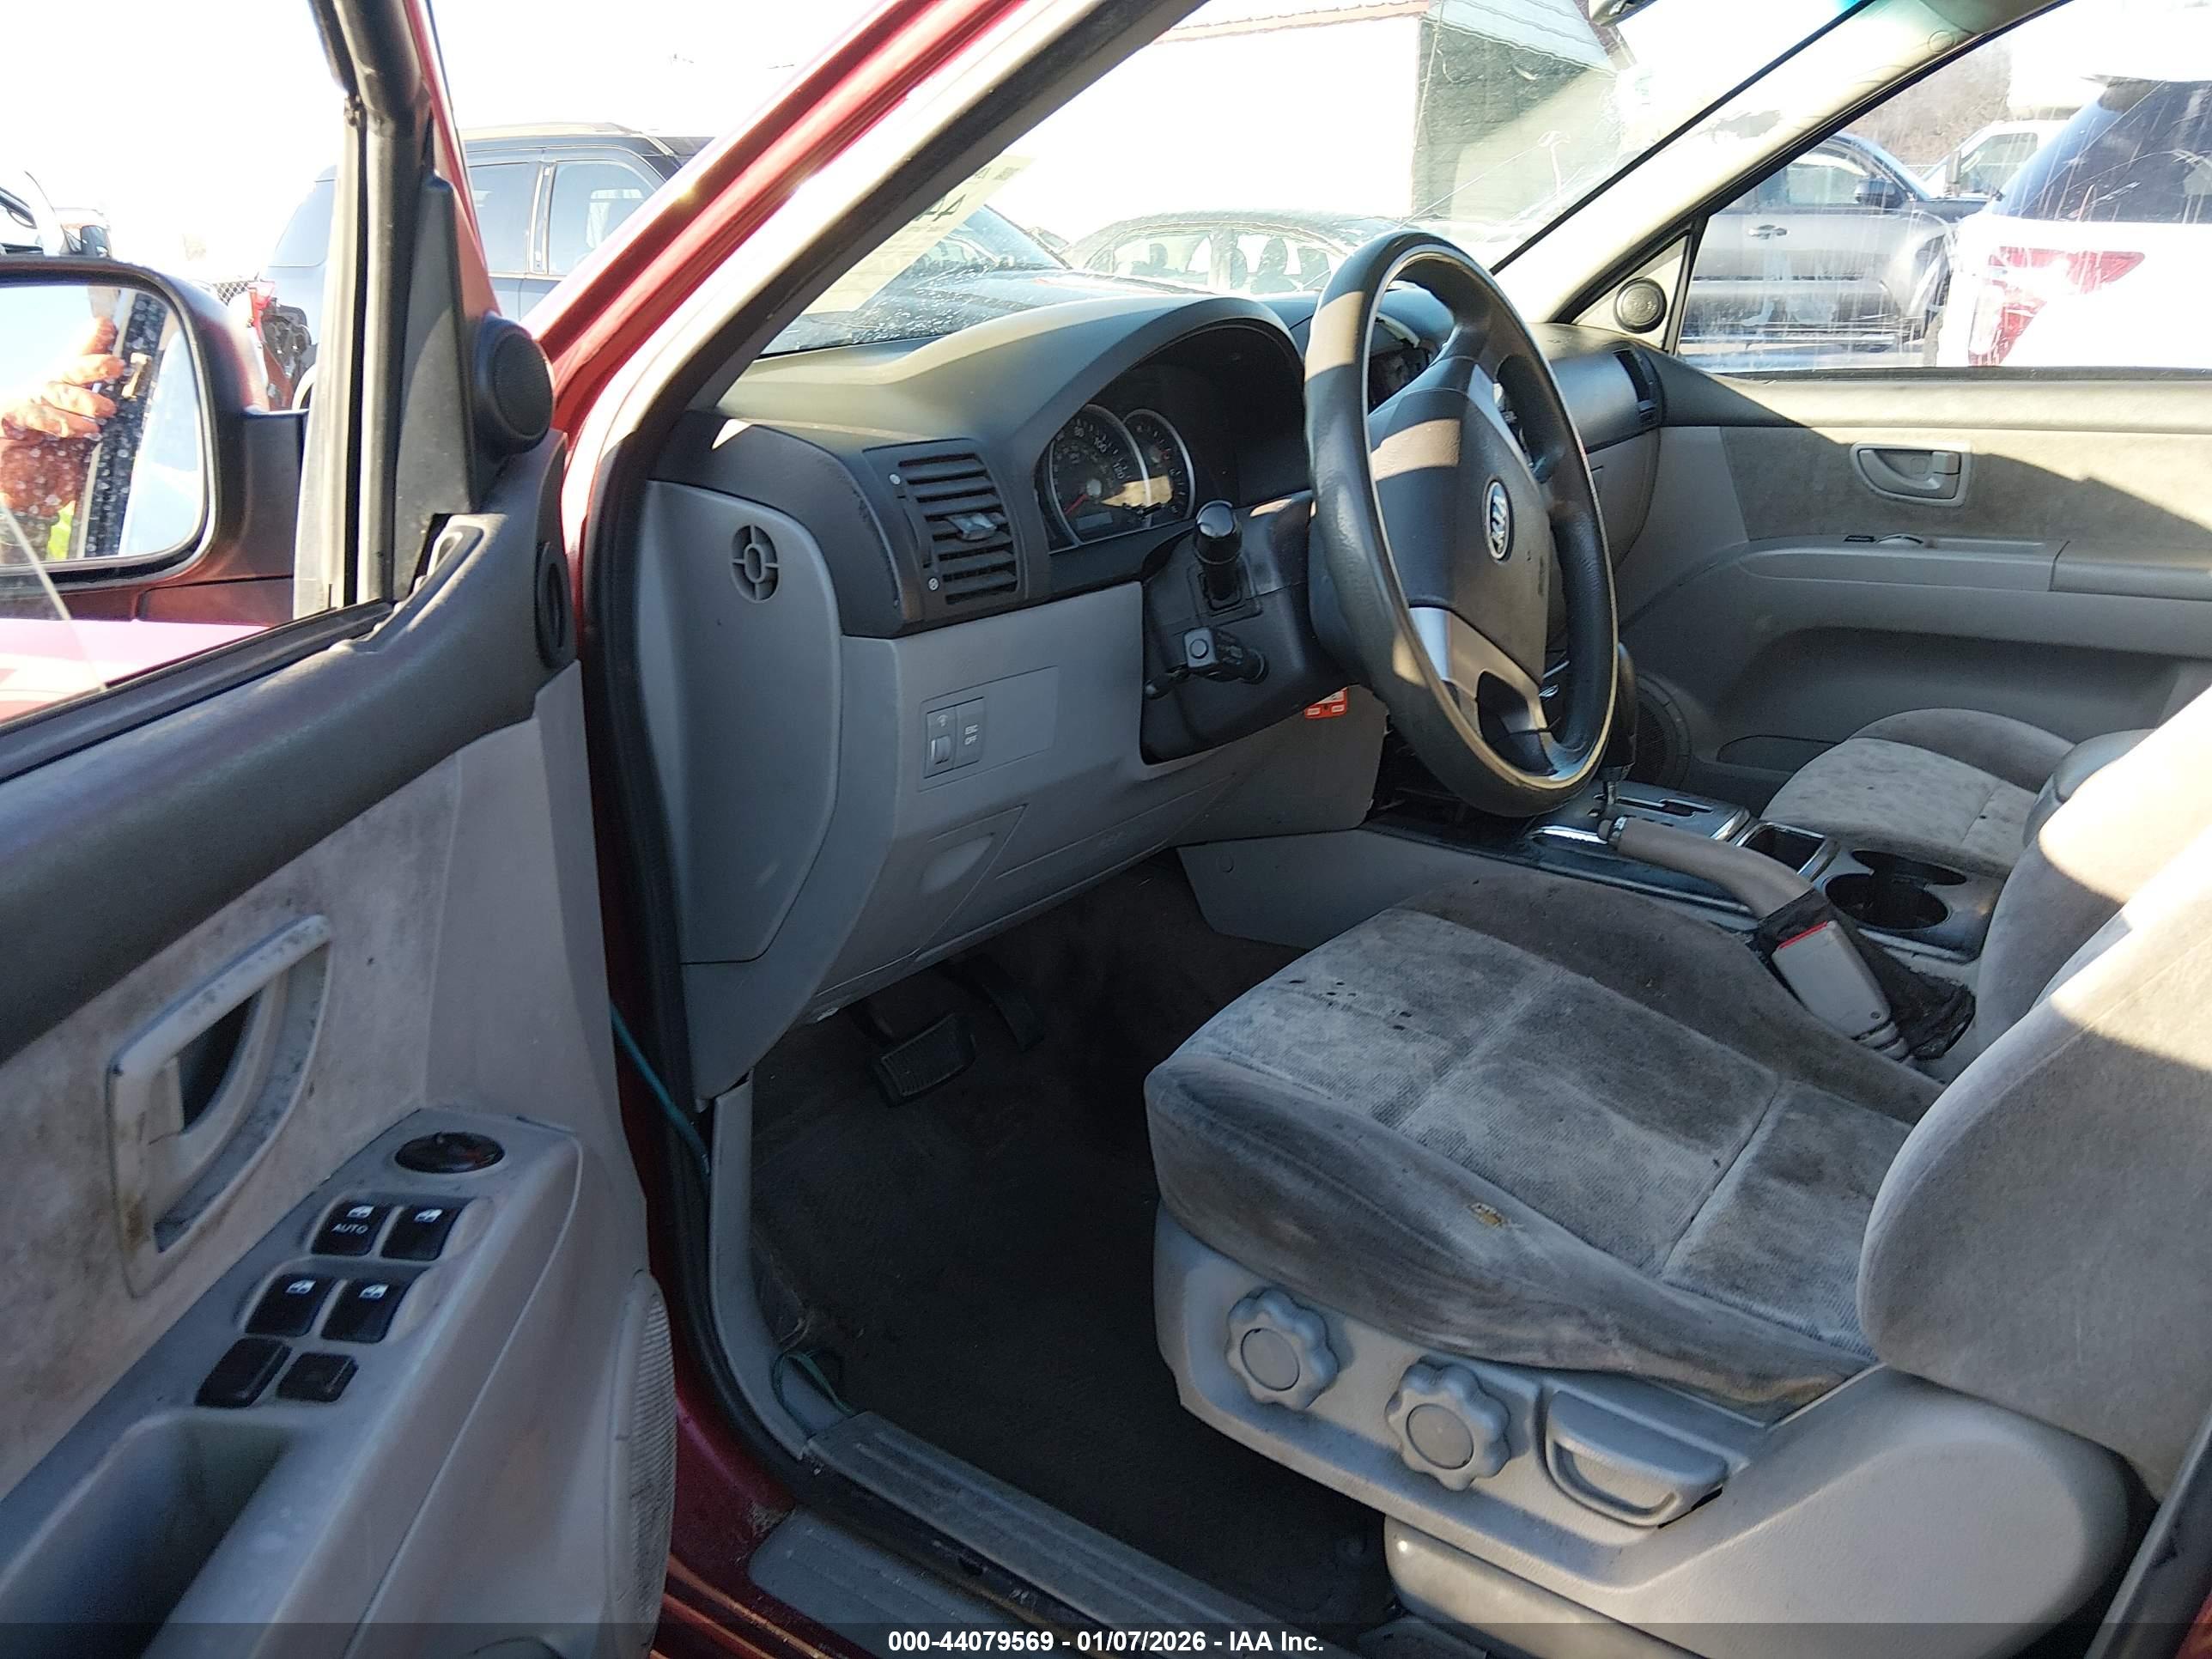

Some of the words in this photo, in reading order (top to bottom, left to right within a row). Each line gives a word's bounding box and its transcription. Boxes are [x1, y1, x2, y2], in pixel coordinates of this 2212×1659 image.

[1491, 494, 1507, 553] KIA
[964, 734, 978, 745] OFF
[332, 1223, 369, 1235] AUTO
